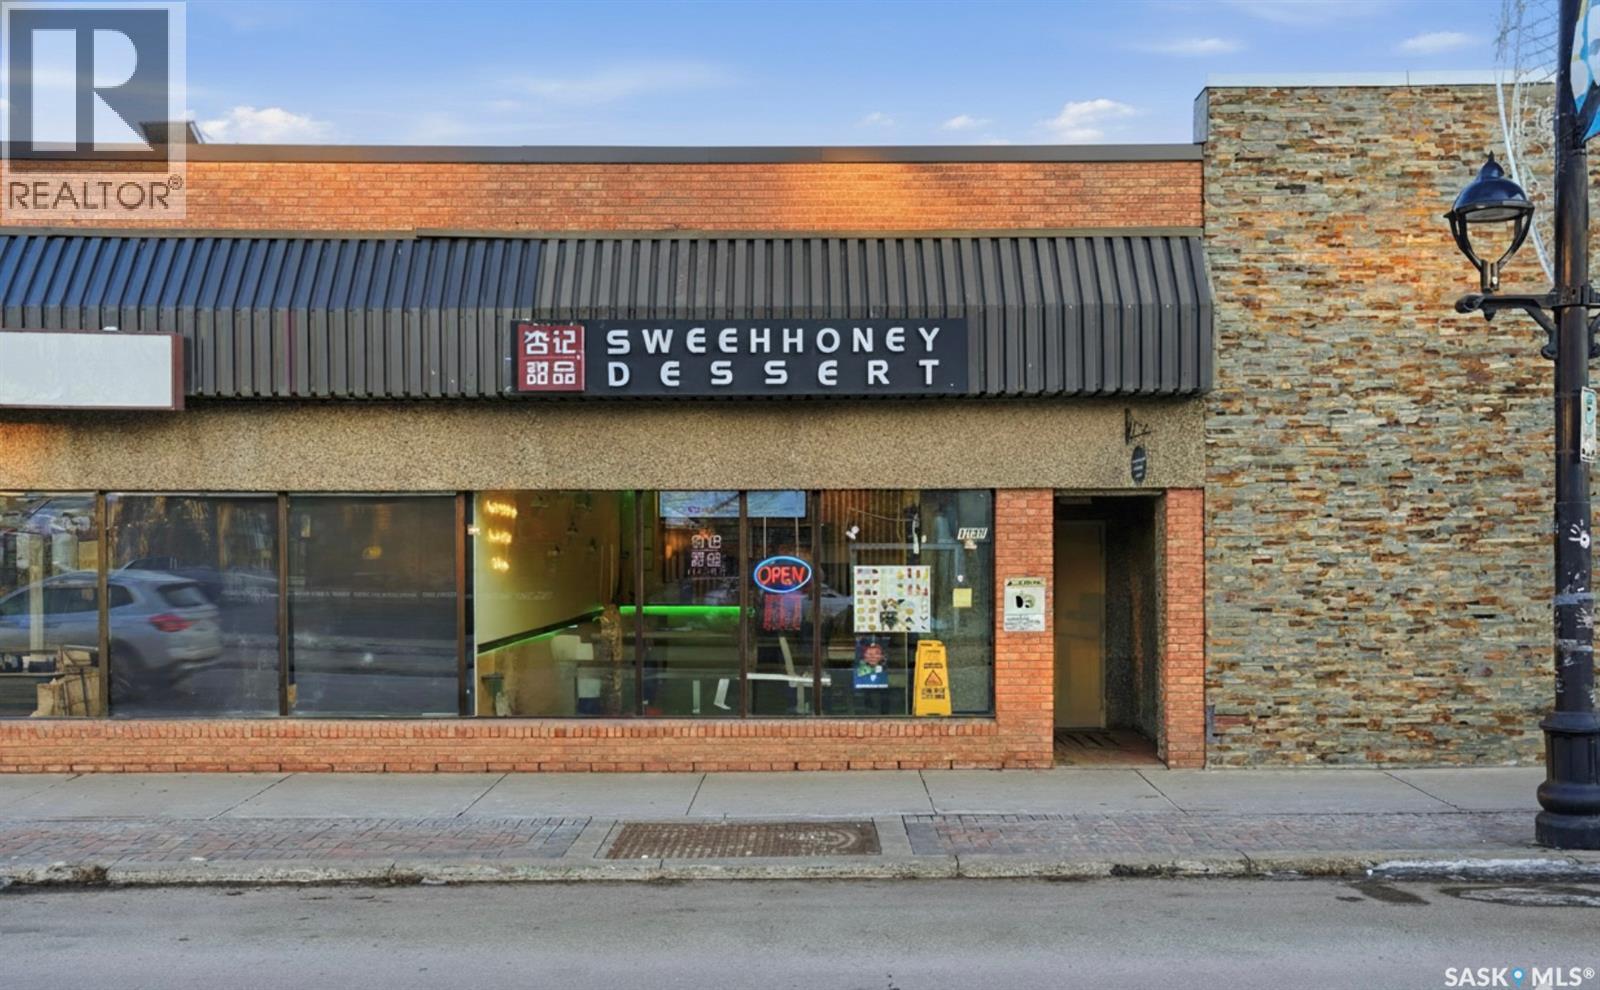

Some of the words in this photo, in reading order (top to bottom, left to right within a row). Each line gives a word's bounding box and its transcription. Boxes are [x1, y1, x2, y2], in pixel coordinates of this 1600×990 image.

[606, 327, 940, 355] SWEEHHONEY
[607, 359, 940, 387] DESSERT
[757, 565, 806, 586] OPEN
